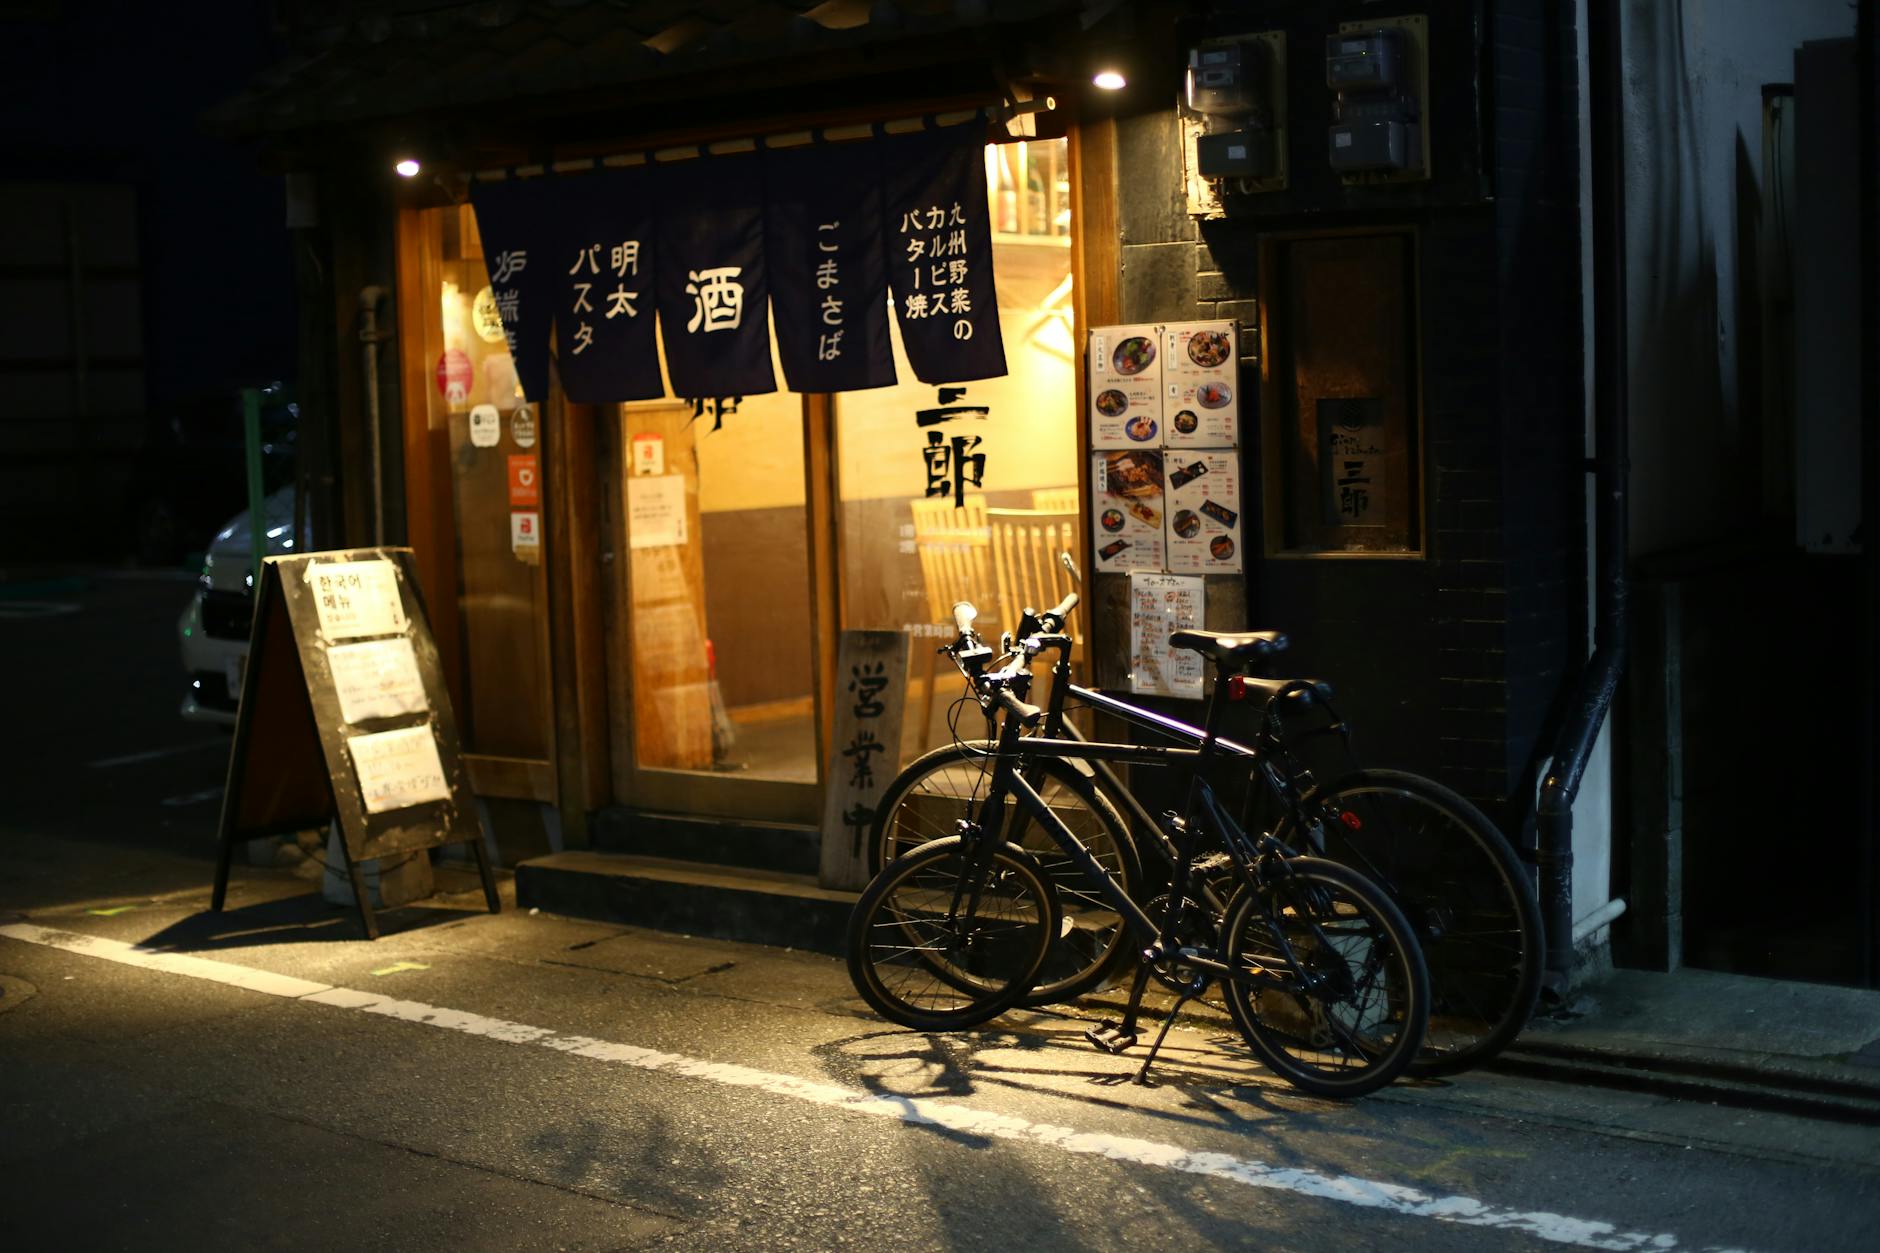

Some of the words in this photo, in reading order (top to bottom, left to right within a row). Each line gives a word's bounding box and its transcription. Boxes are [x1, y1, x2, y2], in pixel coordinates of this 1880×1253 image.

[569, 243, 602, 355] パスタ
[605, 241, 639, 319] 明太
[685, 267, 744, 334] 酒
[816, 221, 844, 360] ごまさば
[900, 209, 928, 319] バター焼
[926, 206, 949, 315] カルピス
[948, 202, 973, 340] 九州野菜の
[1338, 461, 1370, 517] 三郎
[842, 661, 889, 858] 営業中
